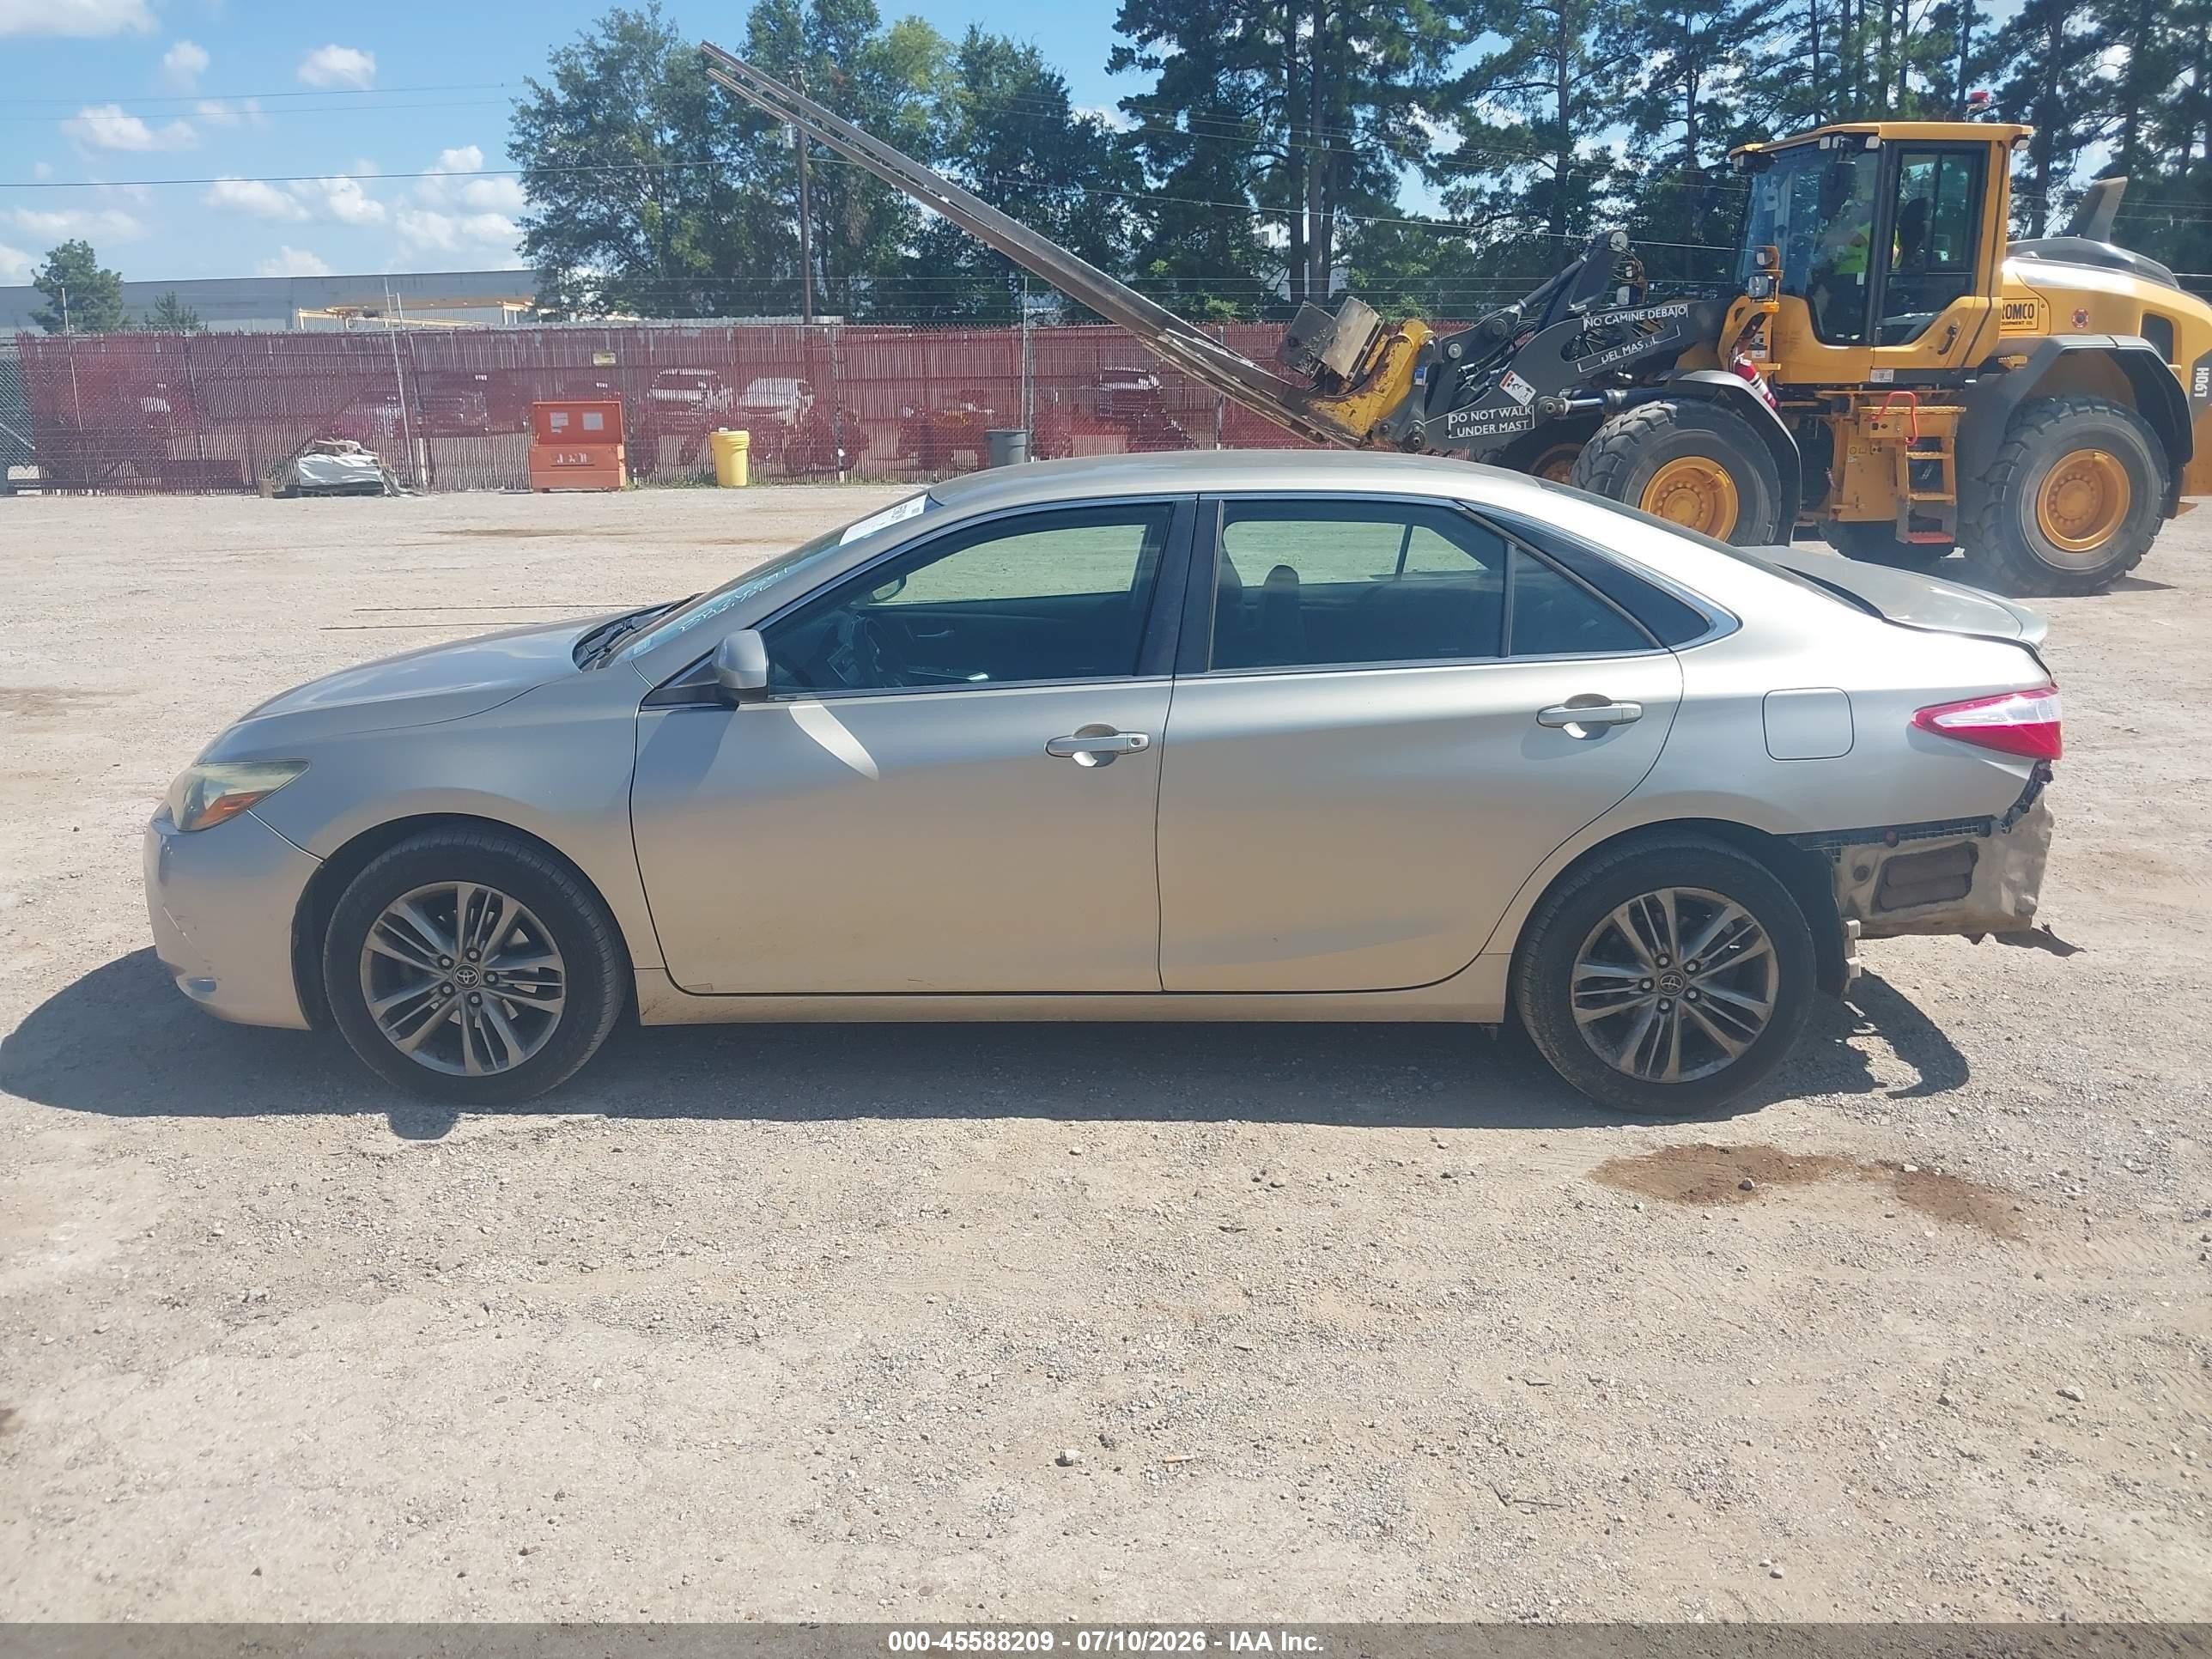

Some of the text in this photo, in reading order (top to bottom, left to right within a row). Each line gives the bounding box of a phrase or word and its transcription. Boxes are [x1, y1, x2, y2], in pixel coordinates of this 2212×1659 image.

[1586, 306, 1686, 328] NO CAMINE DEBAJO
[2194, 368, 2209, 398] L90H
[1450, 407, 1532, 424] DO NOT WALK
[1457, 420, 1528, 436] UNDER MAST
